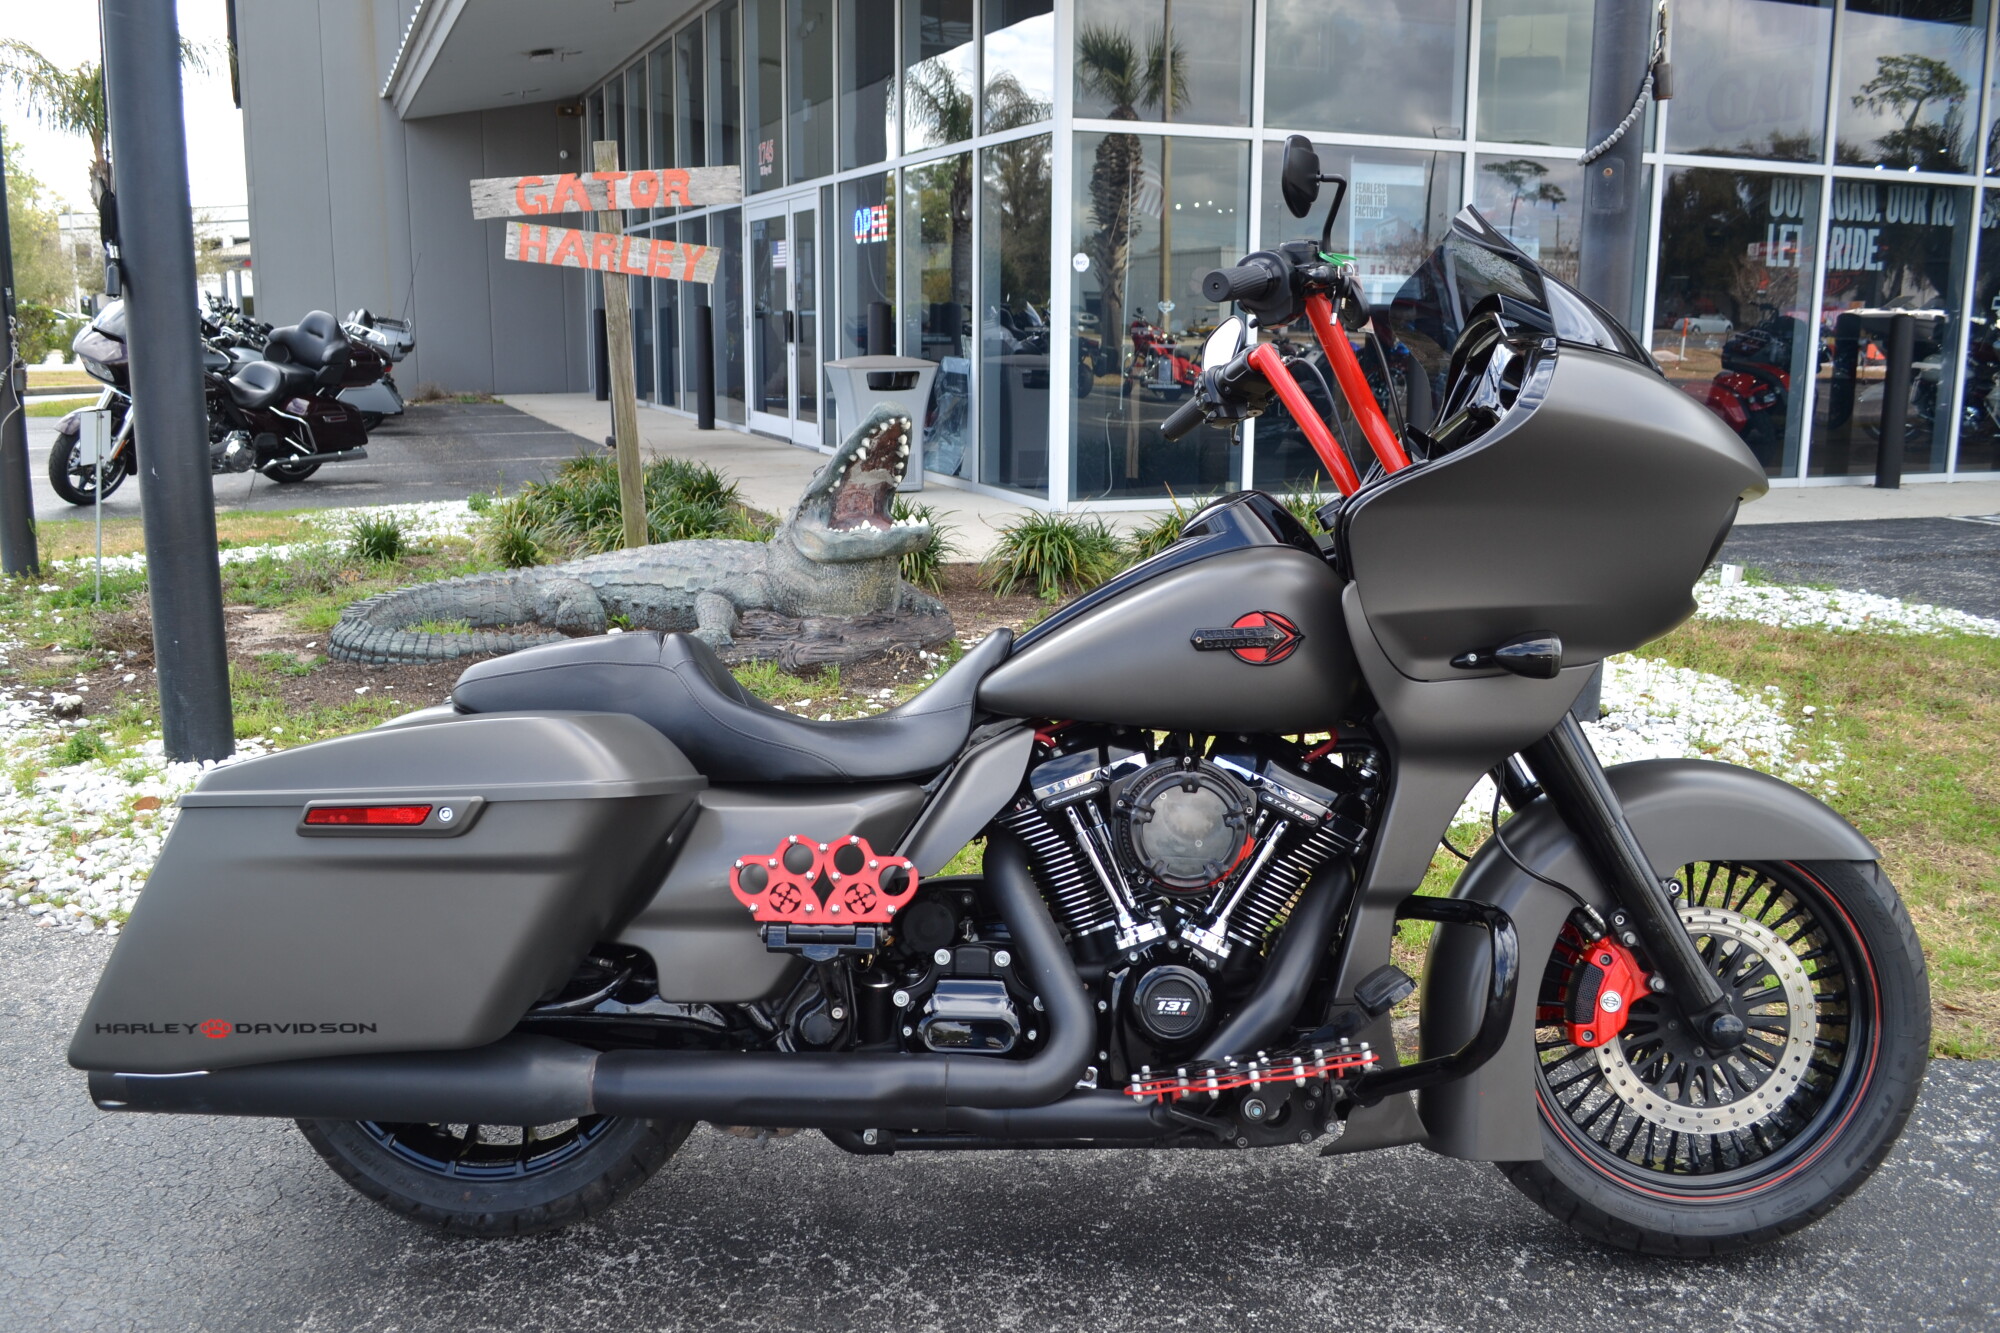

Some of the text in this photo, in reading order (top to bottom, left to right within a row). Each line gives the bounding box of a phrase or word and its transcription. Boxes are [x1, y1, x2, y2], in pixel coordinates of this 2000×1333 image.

[515, 168, 693, 215] GATOR
[1355, 182, 1386, 194] FEARLESS
[1355, 194, 1387, 206] FROM THE
[1886, 185, 1927, 225] OUR
[1354, 206, 1382, 217] FACTORY
[854, 204, 888, 244] OPEN
[518, 222, 707, 282] HARLEY
[1828, 226, 1884, 271] RIDE.
[1203, 638, 1275, 648] DAVIDSON
[1264, 796, 1302, 815] STAGE
[1157, 1001, 1191, 1011] 131
[95, 1023, 377, 1035] HARLEY DAVIDSON
